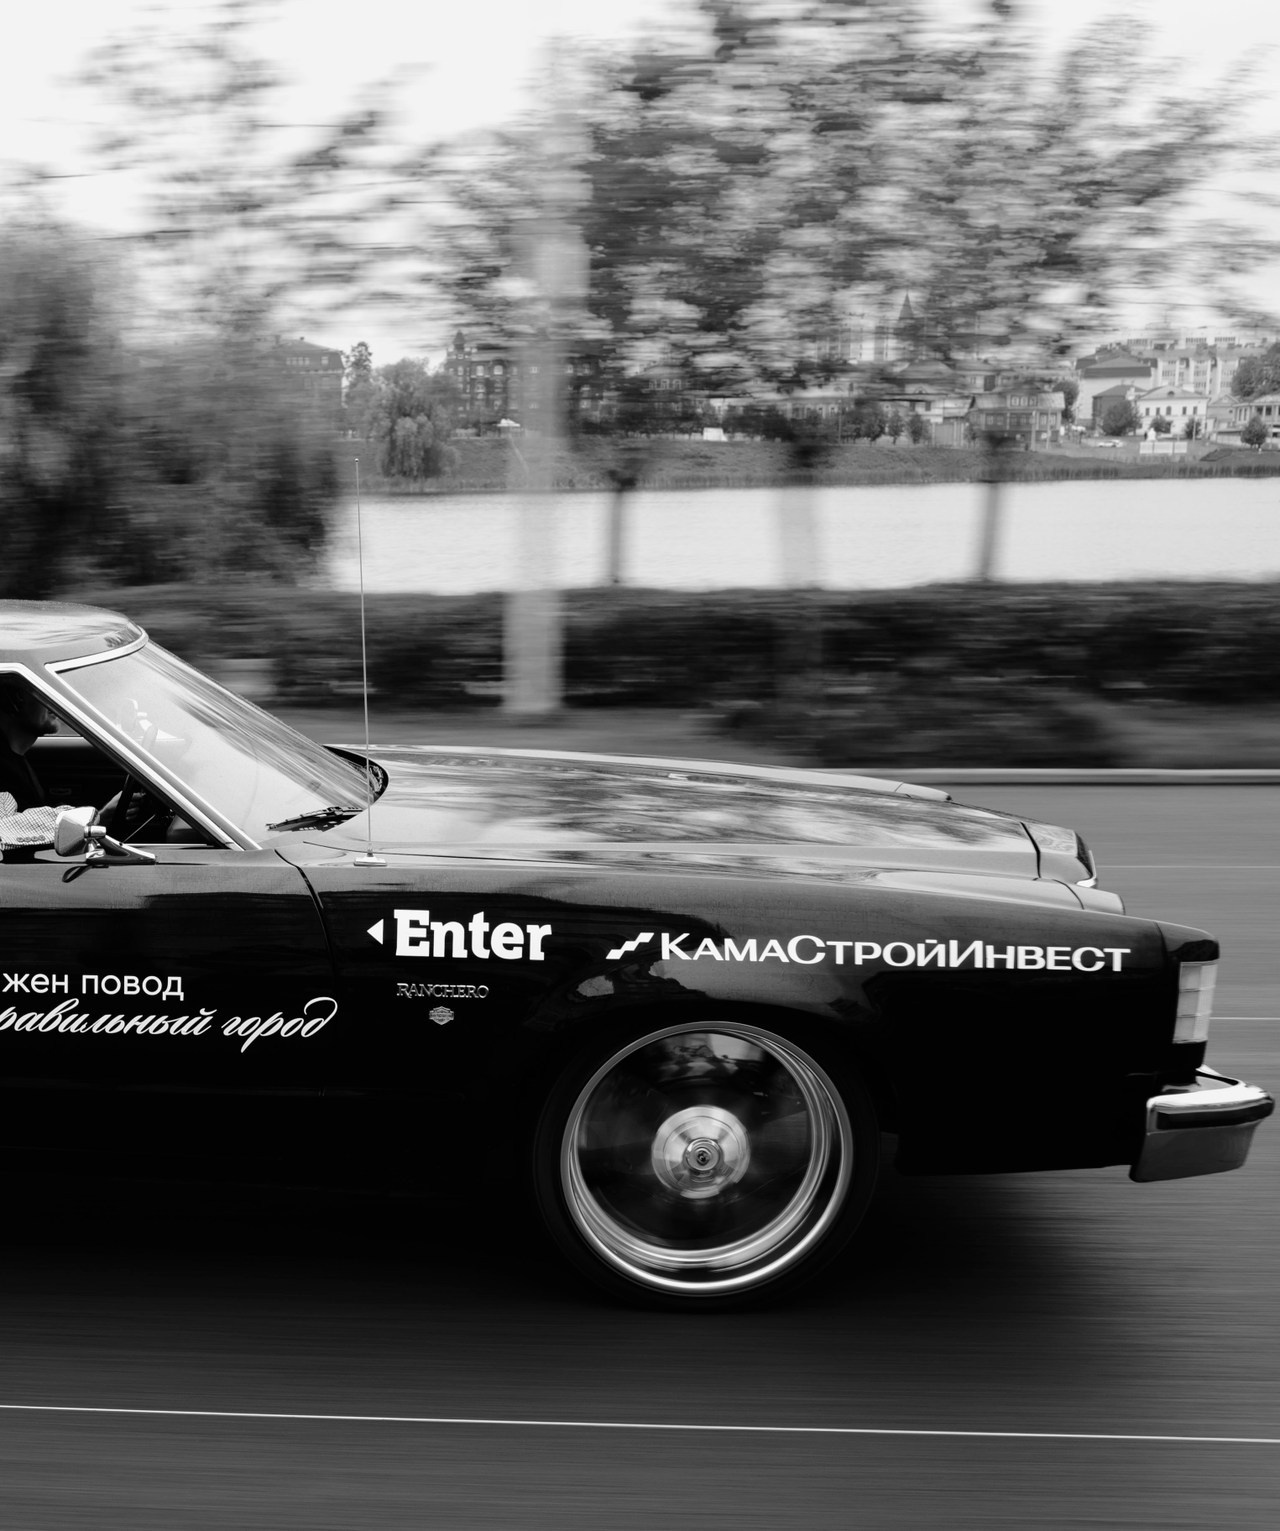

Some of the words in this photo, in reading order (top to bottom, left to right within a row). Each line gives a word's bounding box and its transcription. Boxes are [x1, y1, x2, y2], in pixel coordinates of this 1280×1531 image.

[393, 908, 553, 962] Enter
[81, 974, 185, 1002] повод
[396, 982, 490, 999] RANCHERO
[220, 996, 339, 1054] город
